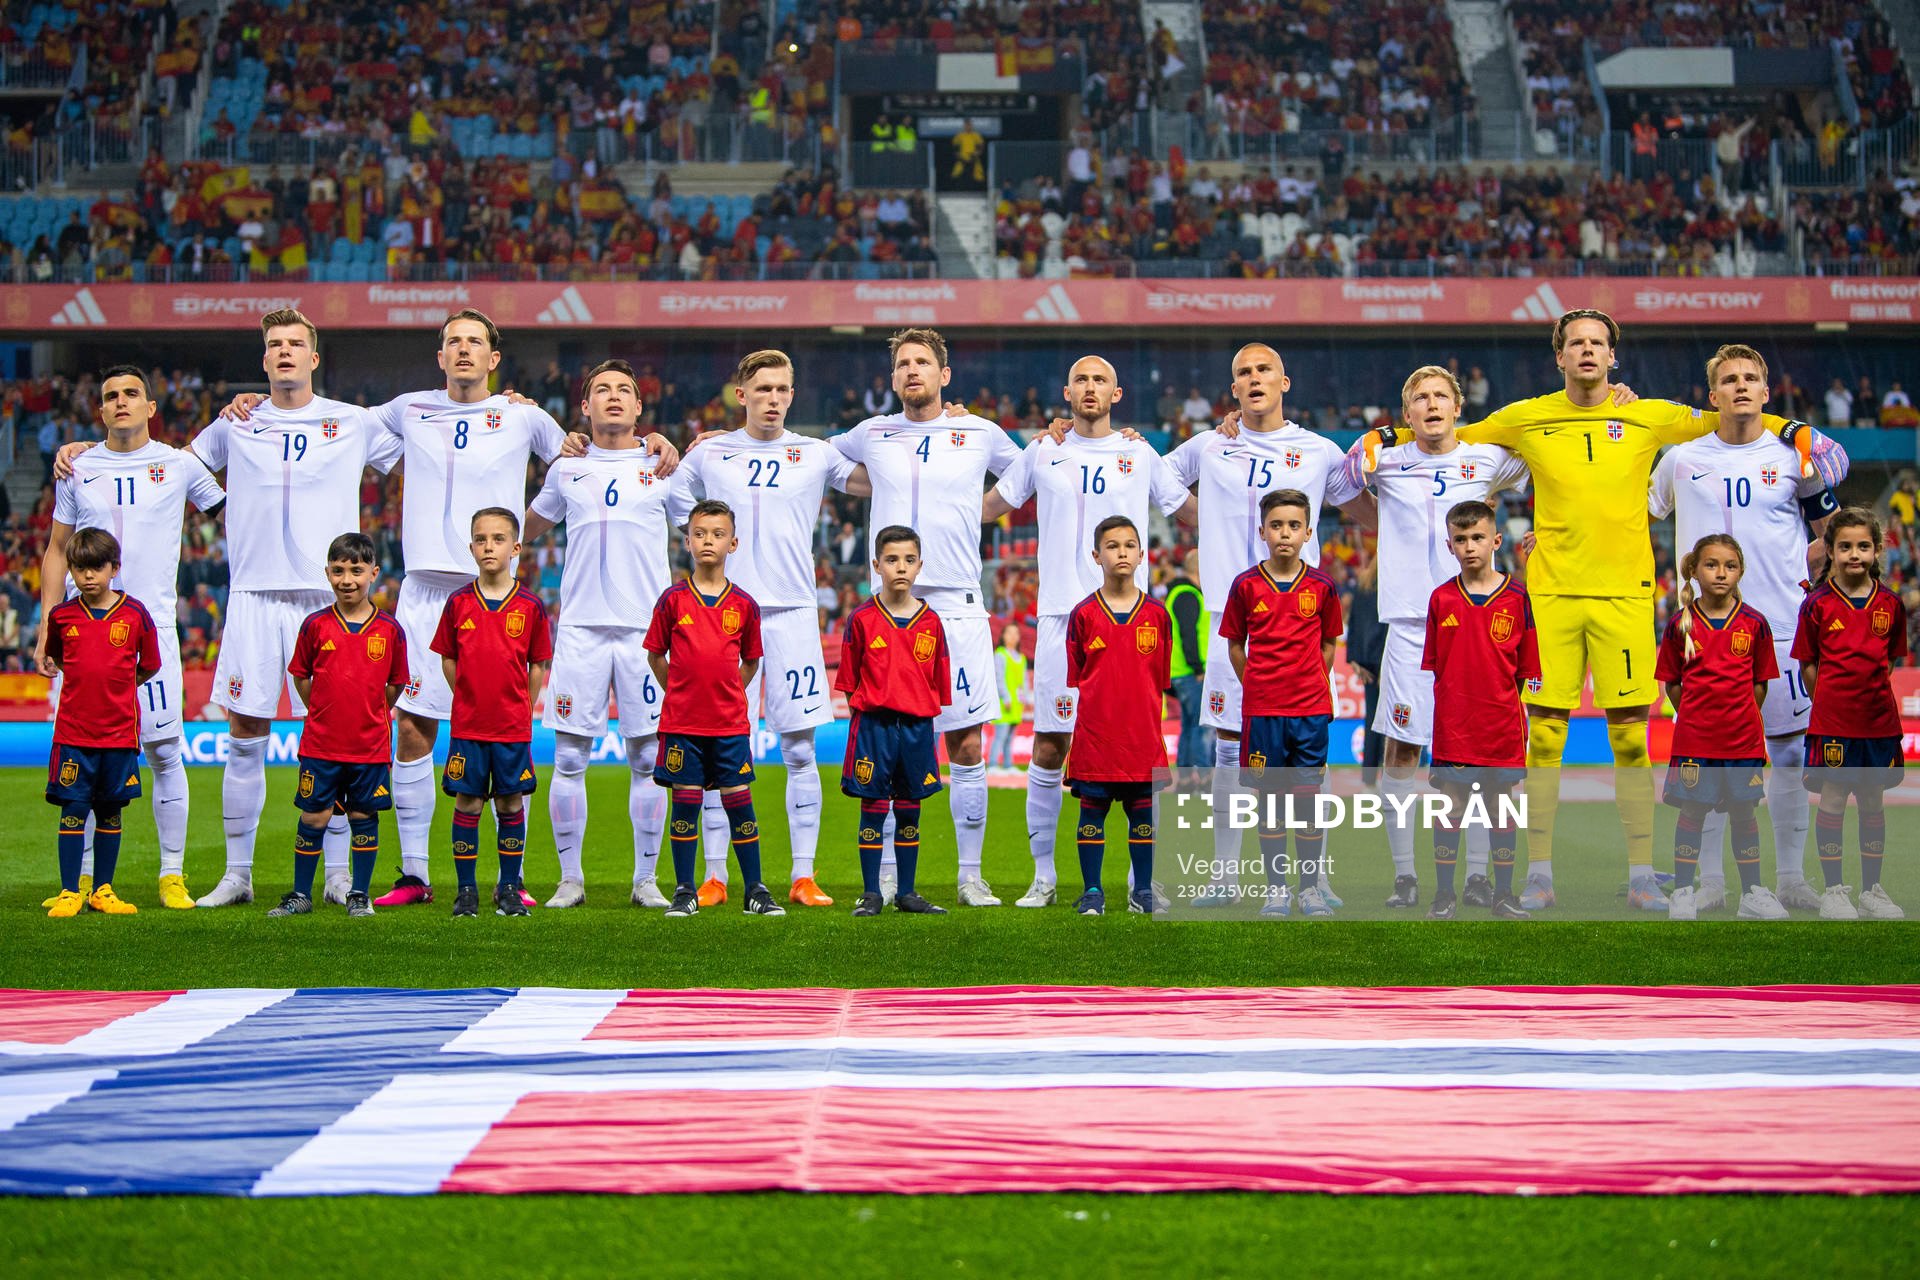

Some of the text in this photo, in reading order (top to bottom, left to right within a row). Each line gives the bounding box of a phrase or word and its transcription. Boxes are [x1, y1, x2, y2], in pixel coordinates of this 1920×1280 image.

[368, 285, 470, 303] finetwork
[855, 284, 956, 301] finetwork
[1342, 282, 1444, 300] finetwork
[1830, 279, 1920, 299] finetwor
[282, 433, 308, 462] 19
[453, 420, 469, 450] 8
[915, 435, 931, 463] 4
[1583, 432, 1593, 462] 1
[747, 459, 780, 488] 22
[1080, 465, 1106, 495] 16
[1247, 457, 1275, 489] 15
[1432, 470, 1448, 497] 5
[114, 477, 135, 506] 11
[604, 478, 619, 507] 6
[1723, 477, 1752, 508] 10
[1820, 492, 1834, 510] C
[1621, 648, 1632, 680] 1
[144, 679, 167, 712] 11
[642, 669, 656, 705] 6
[785, 665, 820, 701] 22
[956, 666, 972, 697] 4
